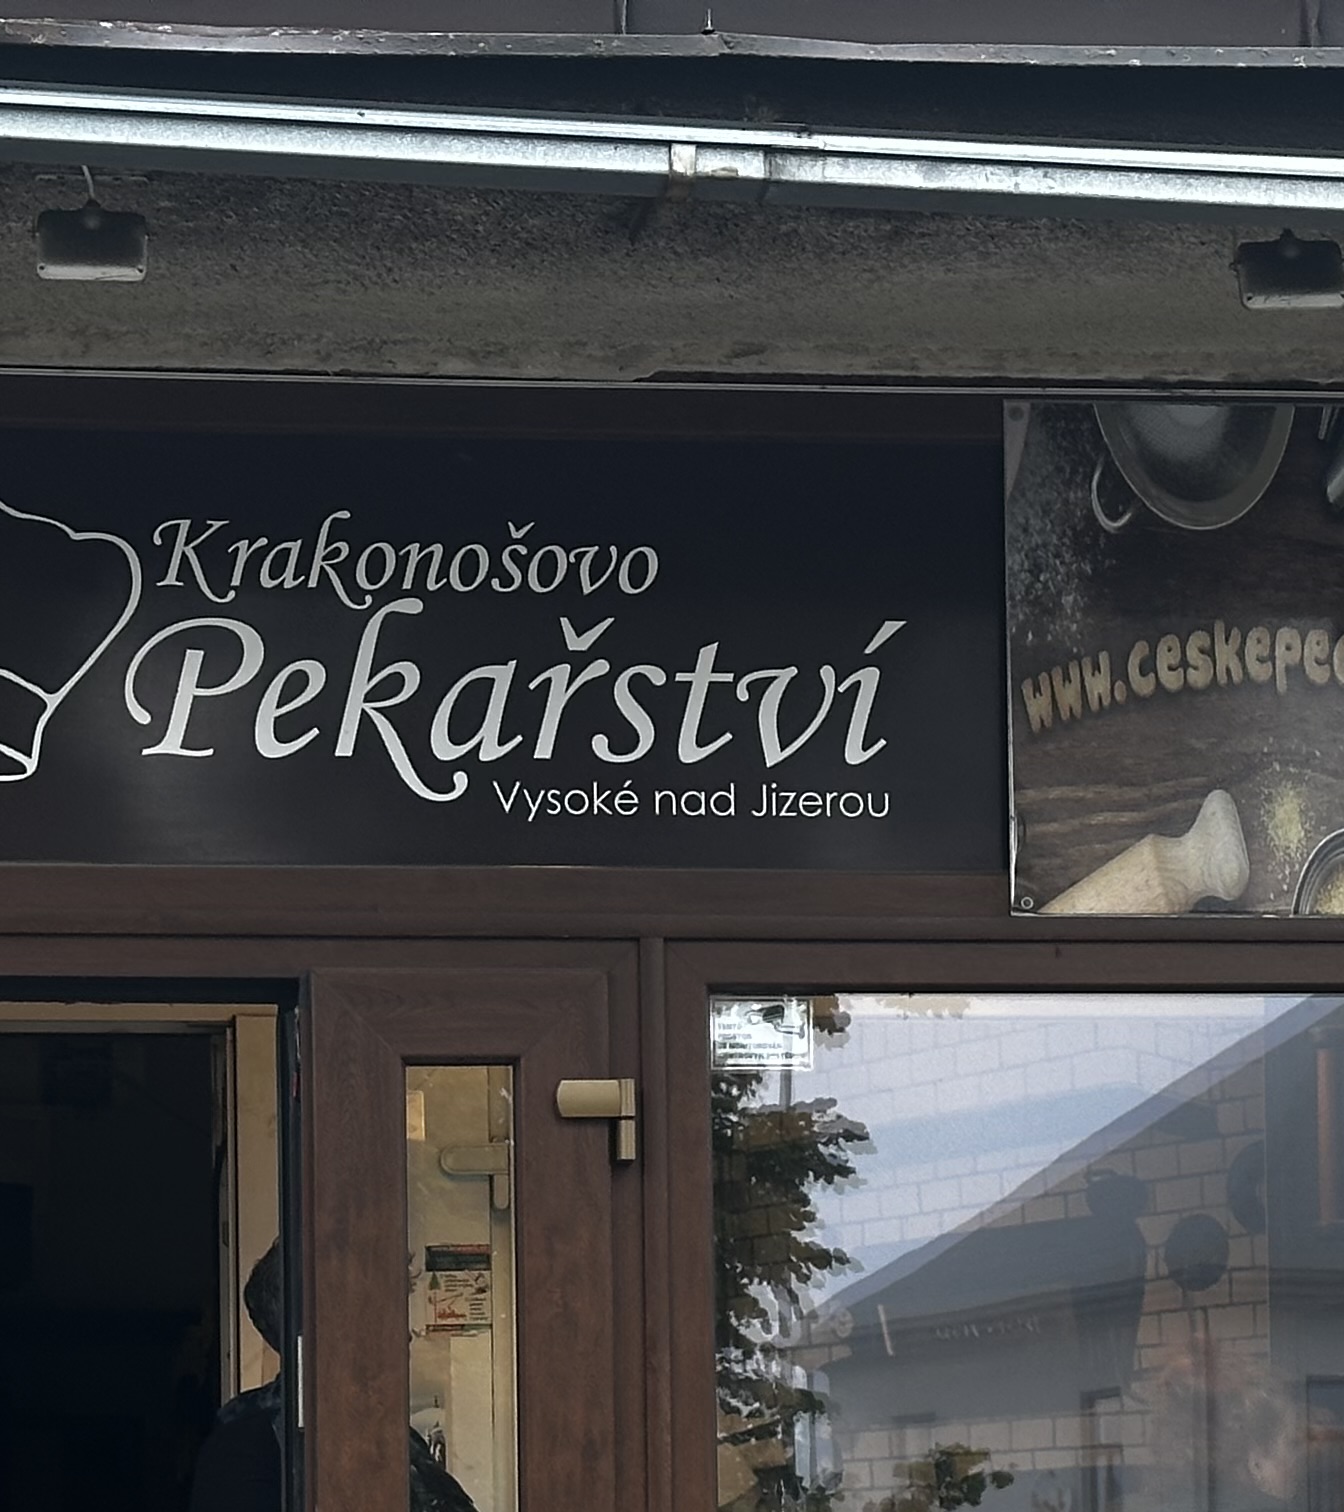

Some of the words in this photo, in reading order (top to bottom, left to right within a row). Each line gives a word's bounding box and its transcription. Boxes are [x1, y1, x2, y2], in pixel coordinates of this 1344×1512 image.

[151, 511, 657, 608] Krakonošovo
[125, 599, 905, 801] Pekařství
[493, 781, 639, 822] Vysoké
[655, 783, 735, 816] nad
[752, 783, 889, 818] Jizerou
